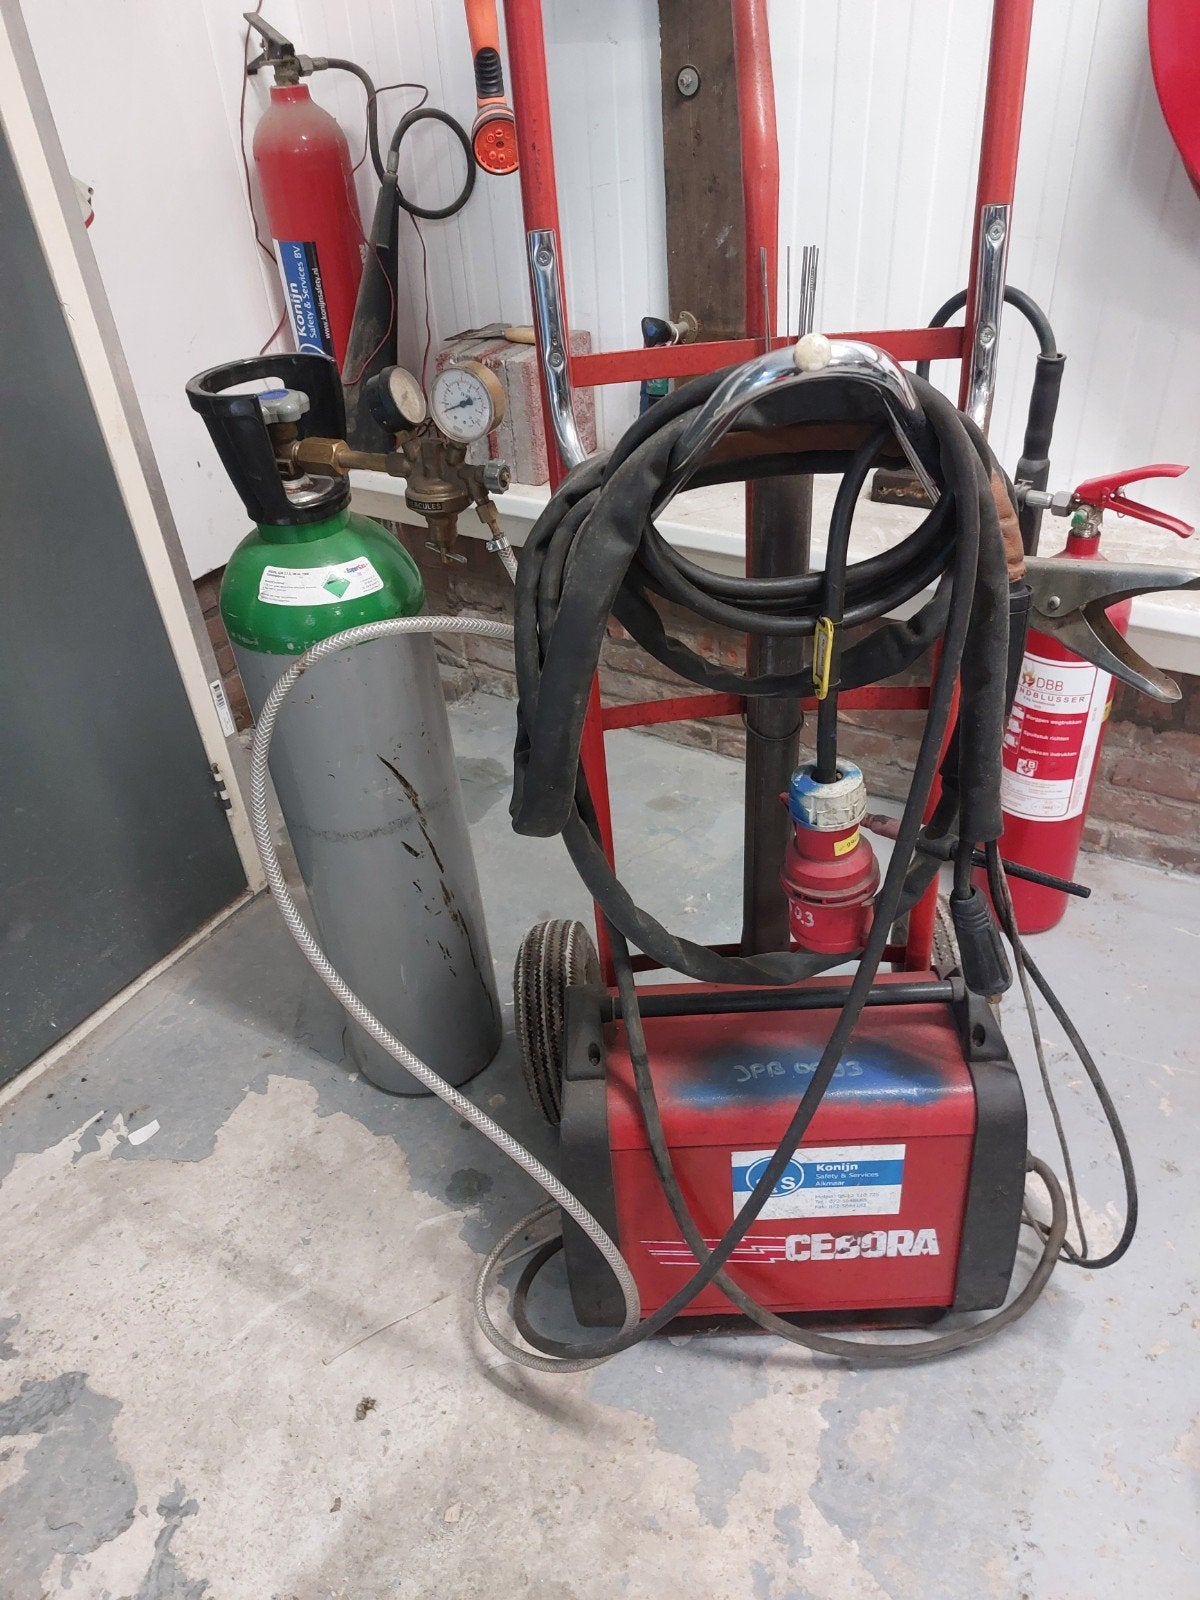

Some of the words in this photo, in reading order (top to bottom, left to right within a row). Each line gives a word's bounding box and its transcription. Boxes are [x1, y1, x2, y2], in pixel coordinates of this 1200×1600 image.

[292, 245, 302, 259] BV
[297, 262, 311, 299] Services
[290, 282, 307, 337] Konijn
[304, 301, 312, 309] &
[312, 267, 331, 339] www.konijnsafety.nl
[307, 311, 317, 339] Safety
[1036, 677, 1064, 692] DBB
[816, 1163, 858, 1173] Konijn
[848, 1171, 880, 1179] Services
[815, 1180, 846, 1188] Alkmaar
